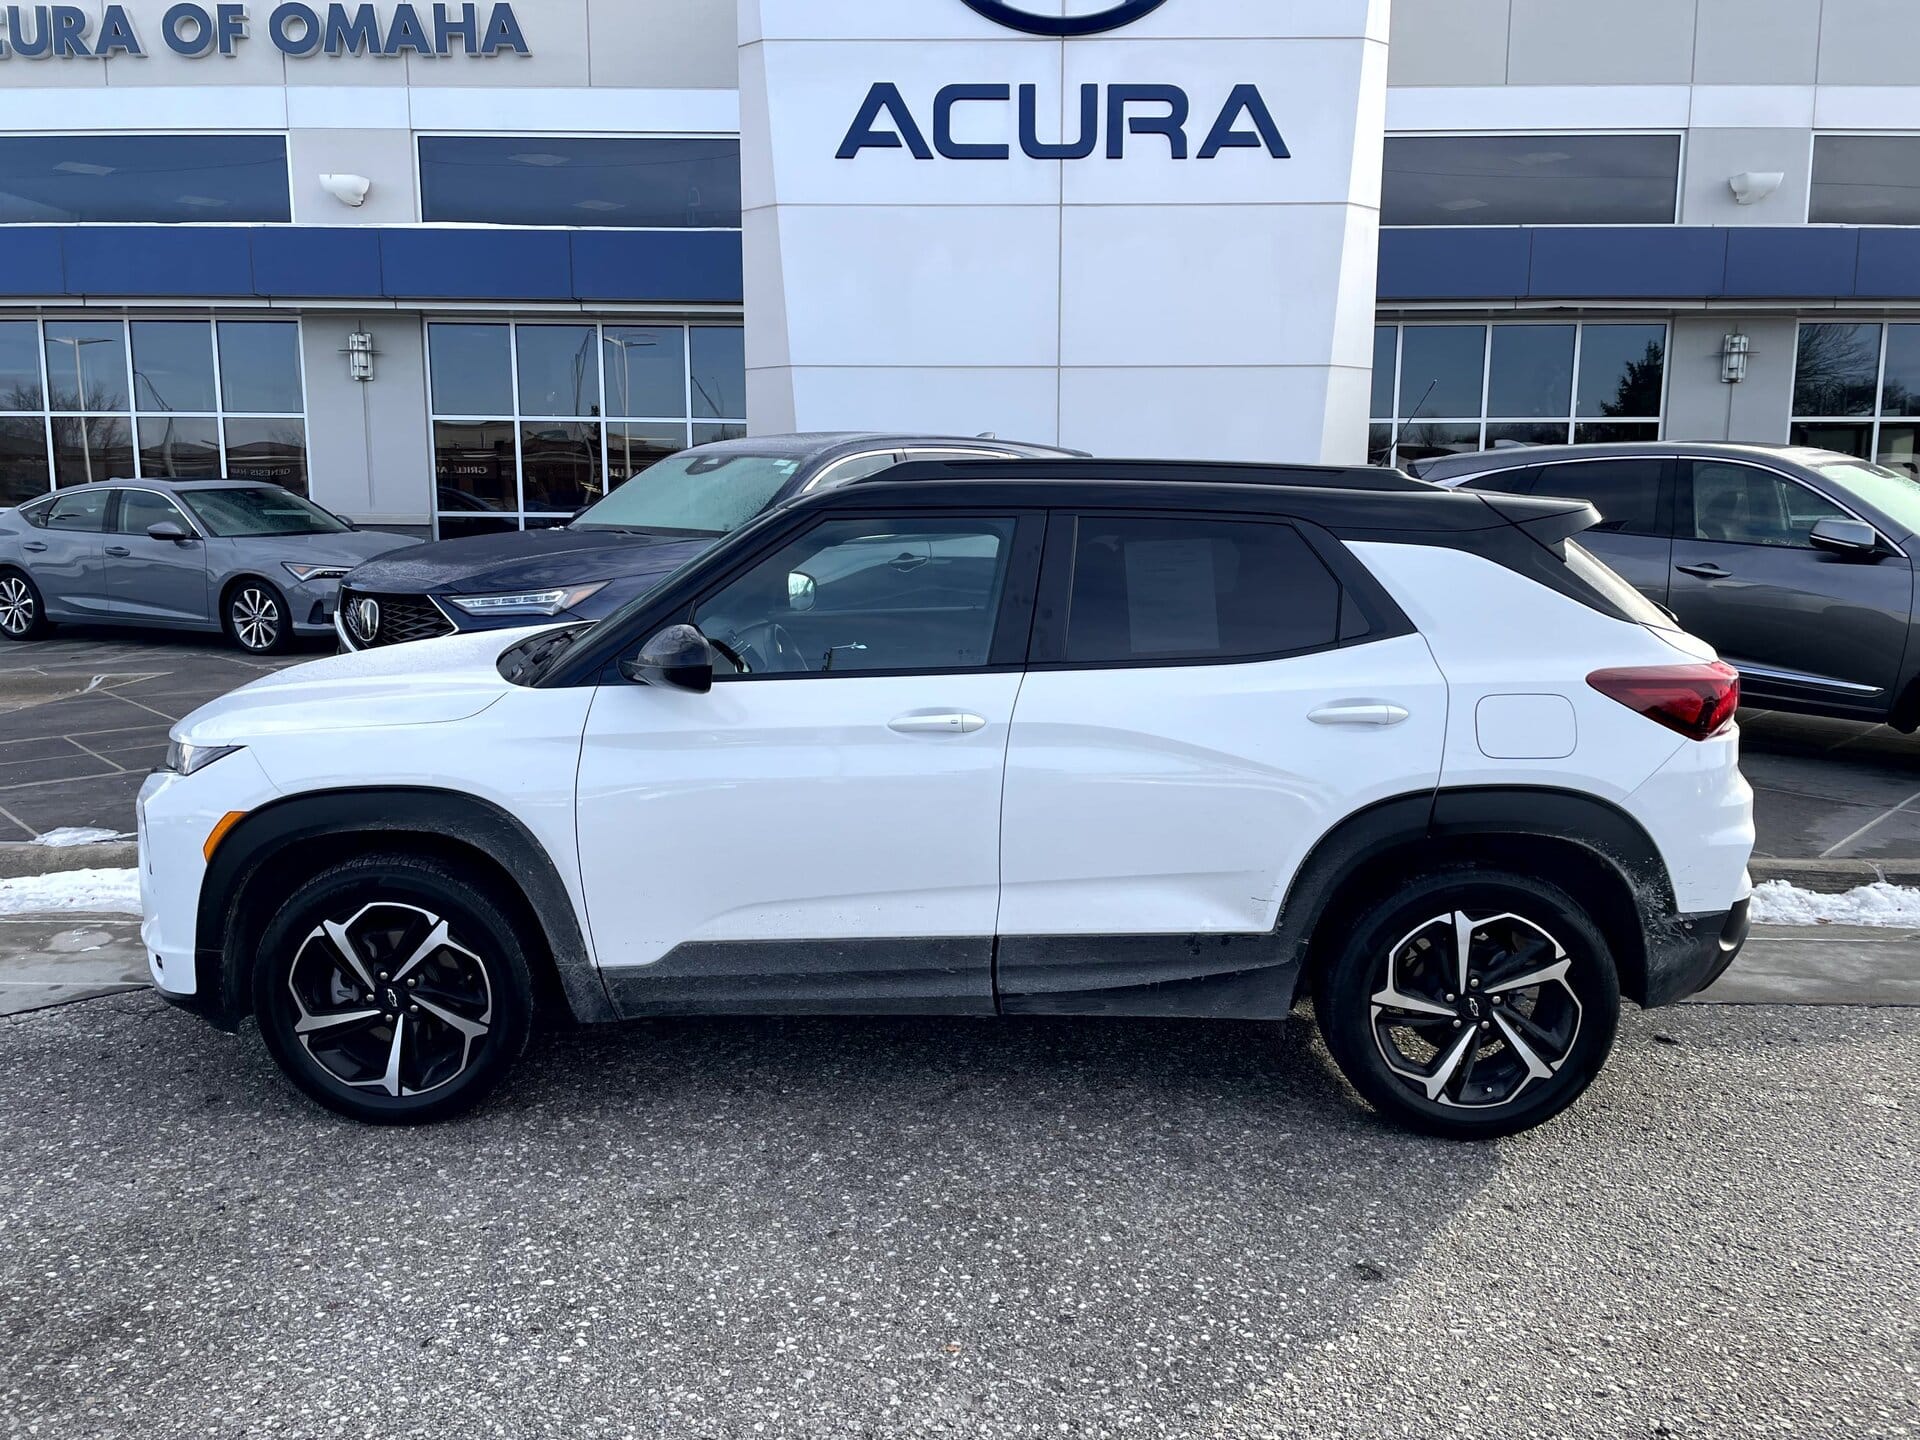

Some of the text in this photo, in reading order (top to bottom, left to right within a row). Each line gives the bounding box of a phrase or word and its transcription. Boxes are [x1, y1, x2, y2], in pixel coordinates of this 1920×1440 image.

[0, 1, 532, 59] URA OF OMAHA
[834, 82, 1291, 160] ACURA
